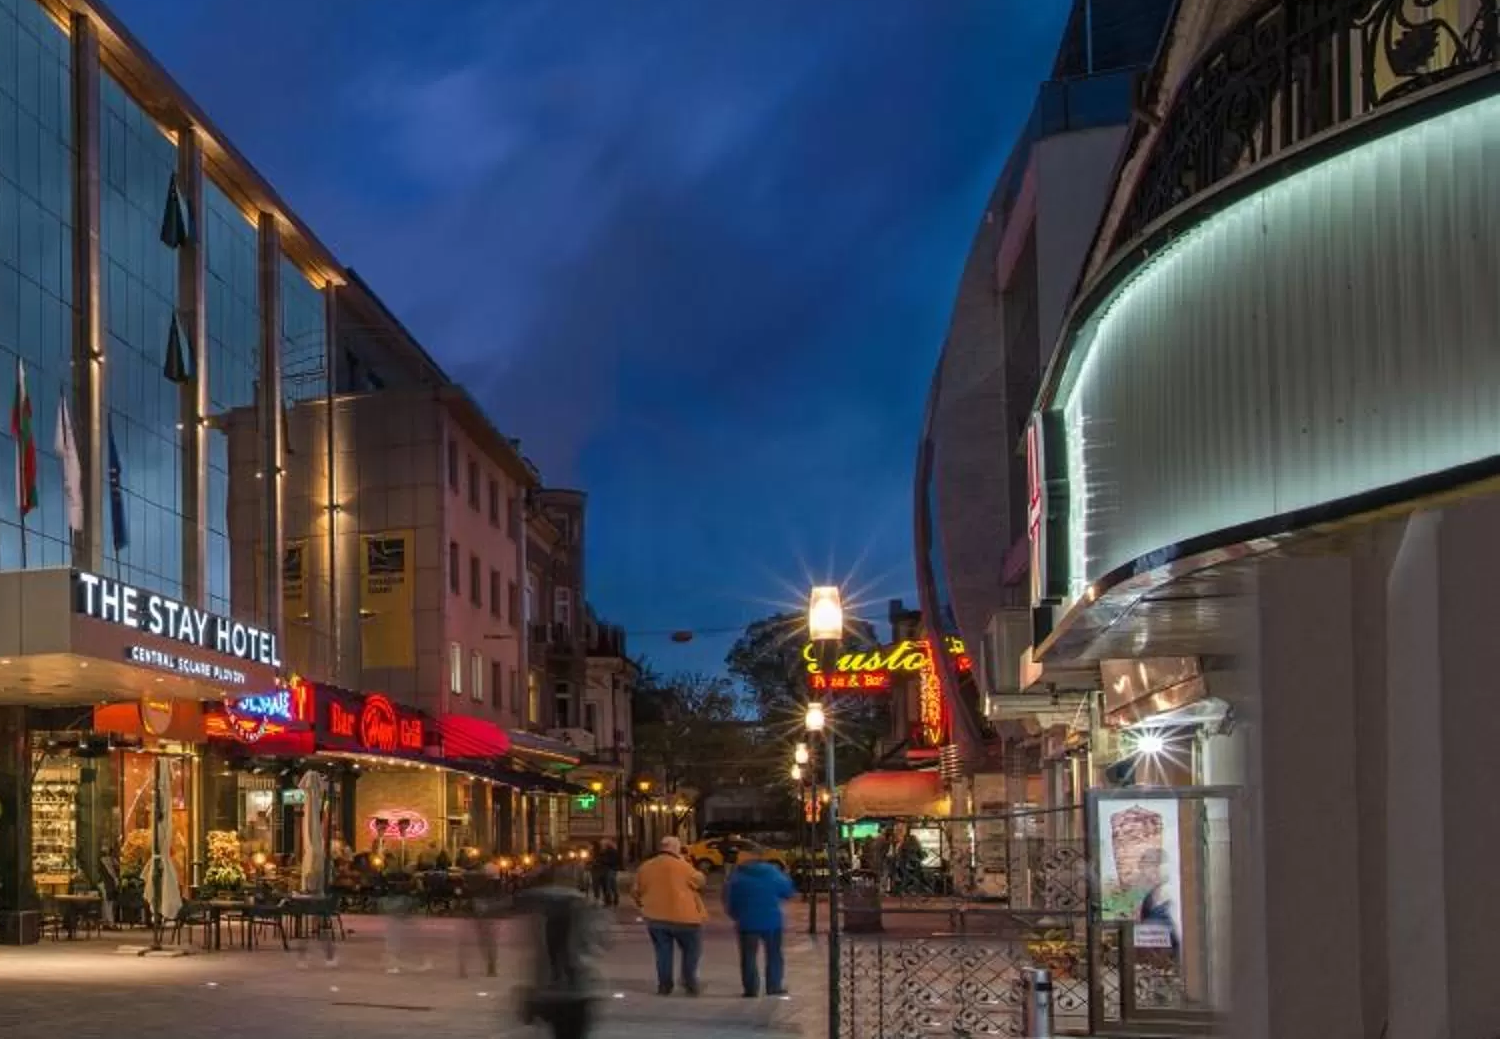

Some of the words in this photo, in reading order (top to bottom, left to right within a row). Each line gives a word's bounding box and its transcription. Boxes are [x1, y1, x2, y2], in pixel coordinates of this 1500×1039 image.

[79, 571, 139, 629] THE
[148, 595, 209, 646] STAY
[215, 616, 282, 667] HOTEL
[130, 645, 175, 668] CENTRAL
